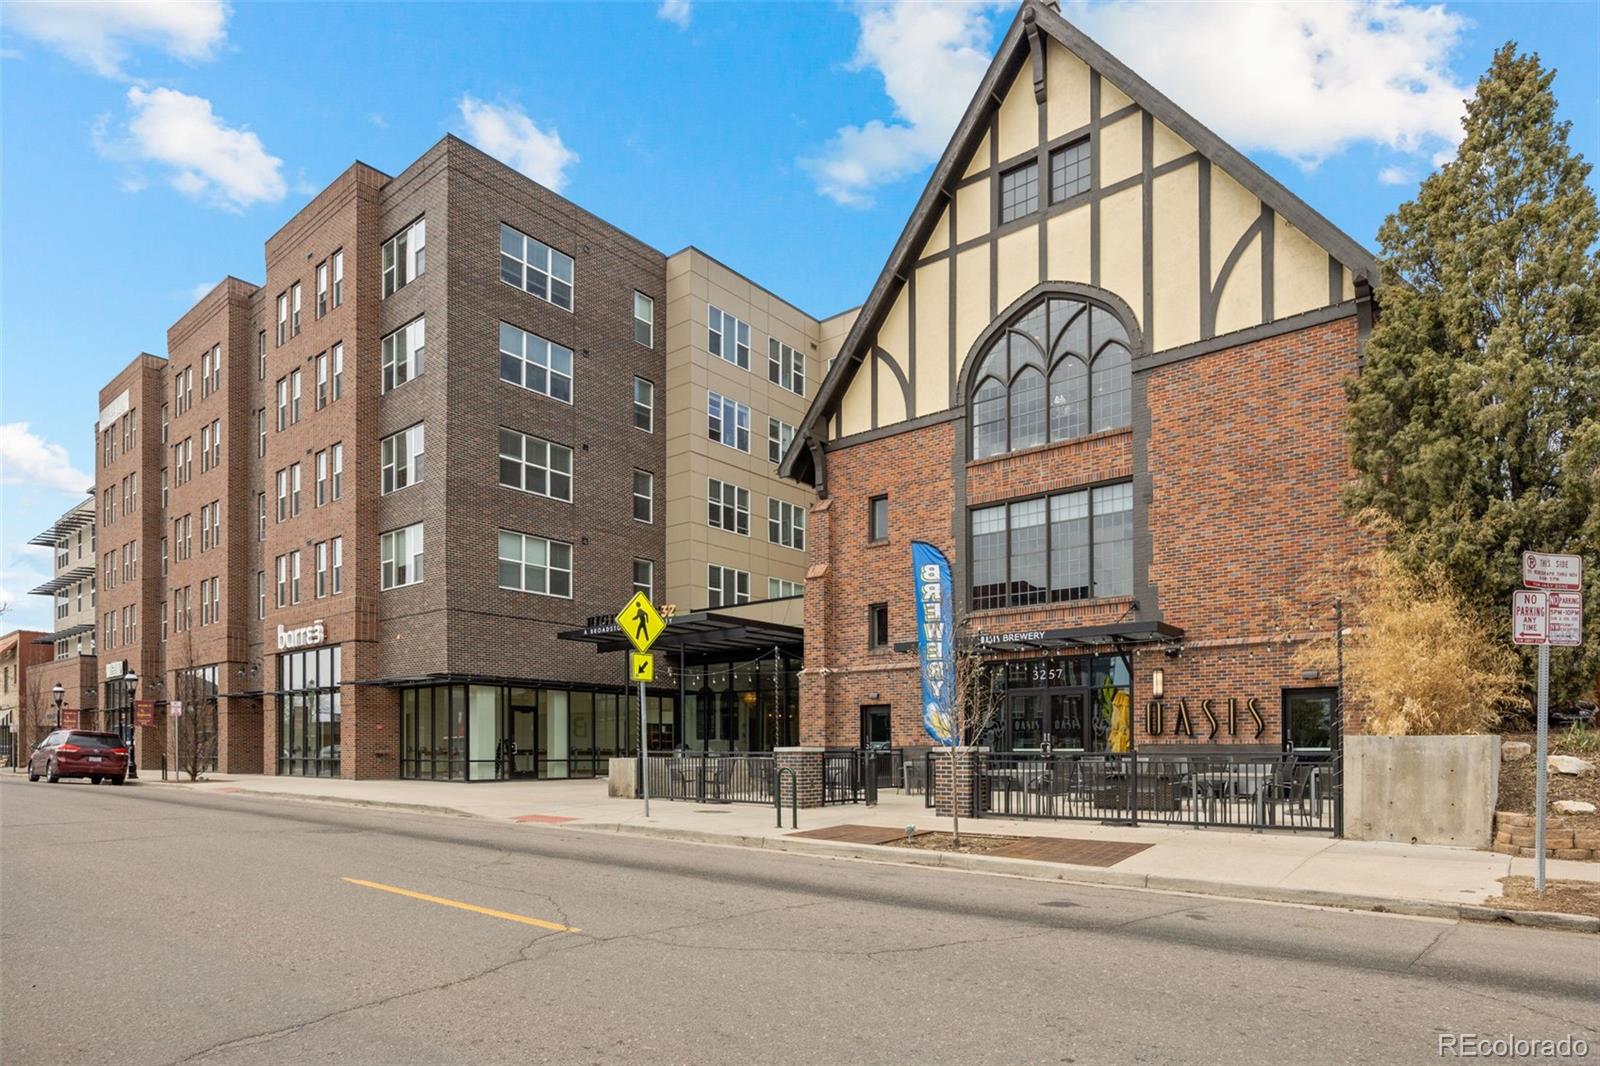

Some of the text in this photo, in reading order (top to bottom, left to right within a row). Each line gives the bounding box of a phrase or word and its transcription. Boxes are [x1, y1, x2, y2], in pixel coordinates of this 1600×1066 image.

[1555, 559, 1569, 569] SIDE
[1524, 594, 1537, 604] NO
[1516, 606, 1545, 617] PARKING
[590, 626, 621, 634] BROADSTO
[1522, 623, 1537, 632] TIME
[1002, 631, 1046, 642] BREWERY
[1032, 668, 1063, 680] 3257
[1145, 697, 1265, 740] OASIS
